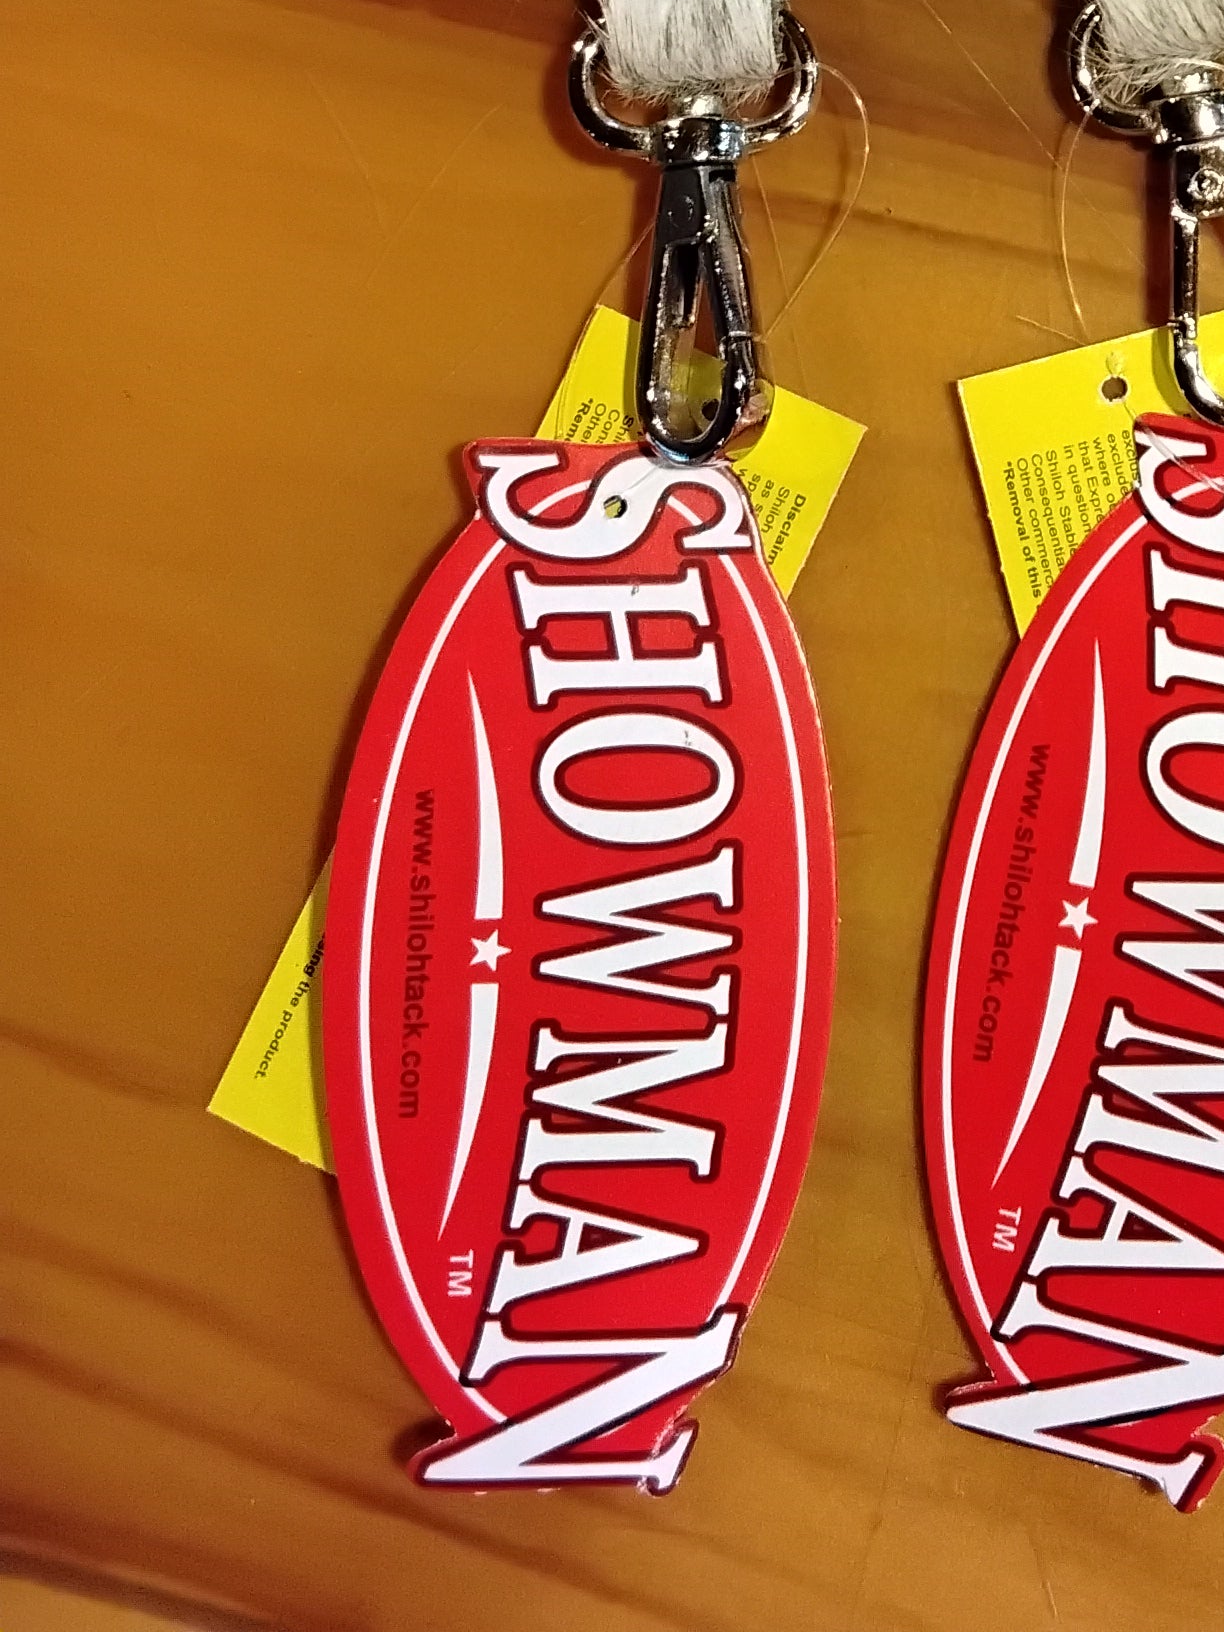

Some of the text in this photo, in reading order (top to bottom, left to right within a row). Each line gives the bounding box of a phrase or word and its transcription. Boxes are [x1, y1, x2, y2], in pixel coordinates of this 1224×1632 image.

[1045, 449, 1066, 501] Shiloh
[1063, 444, 1076, 460] in
[1077, 440, 1094, 473] that
[1092, 436, 1112, 487] where
[761, 479, 775, 499] as
[1016, 457, 1035, 504] Other
[761, 486, 790, 534] Shiloh
[1022, 545, 1036, 564] of
[1026, 566, 1042, 599] this
[974, 743, 1051, 1063] www.shilohtack.com
[399, 788, 437, 1119] www.shilohtack.com
[416, 448, 752, 1492] SHOWMAN
[290, 980, 310, 1008] the
[254, 1009, 293, 1080] product.
[991, 1206, 1025, 1255] TM
[449, 1248, 475, 1298] TM
